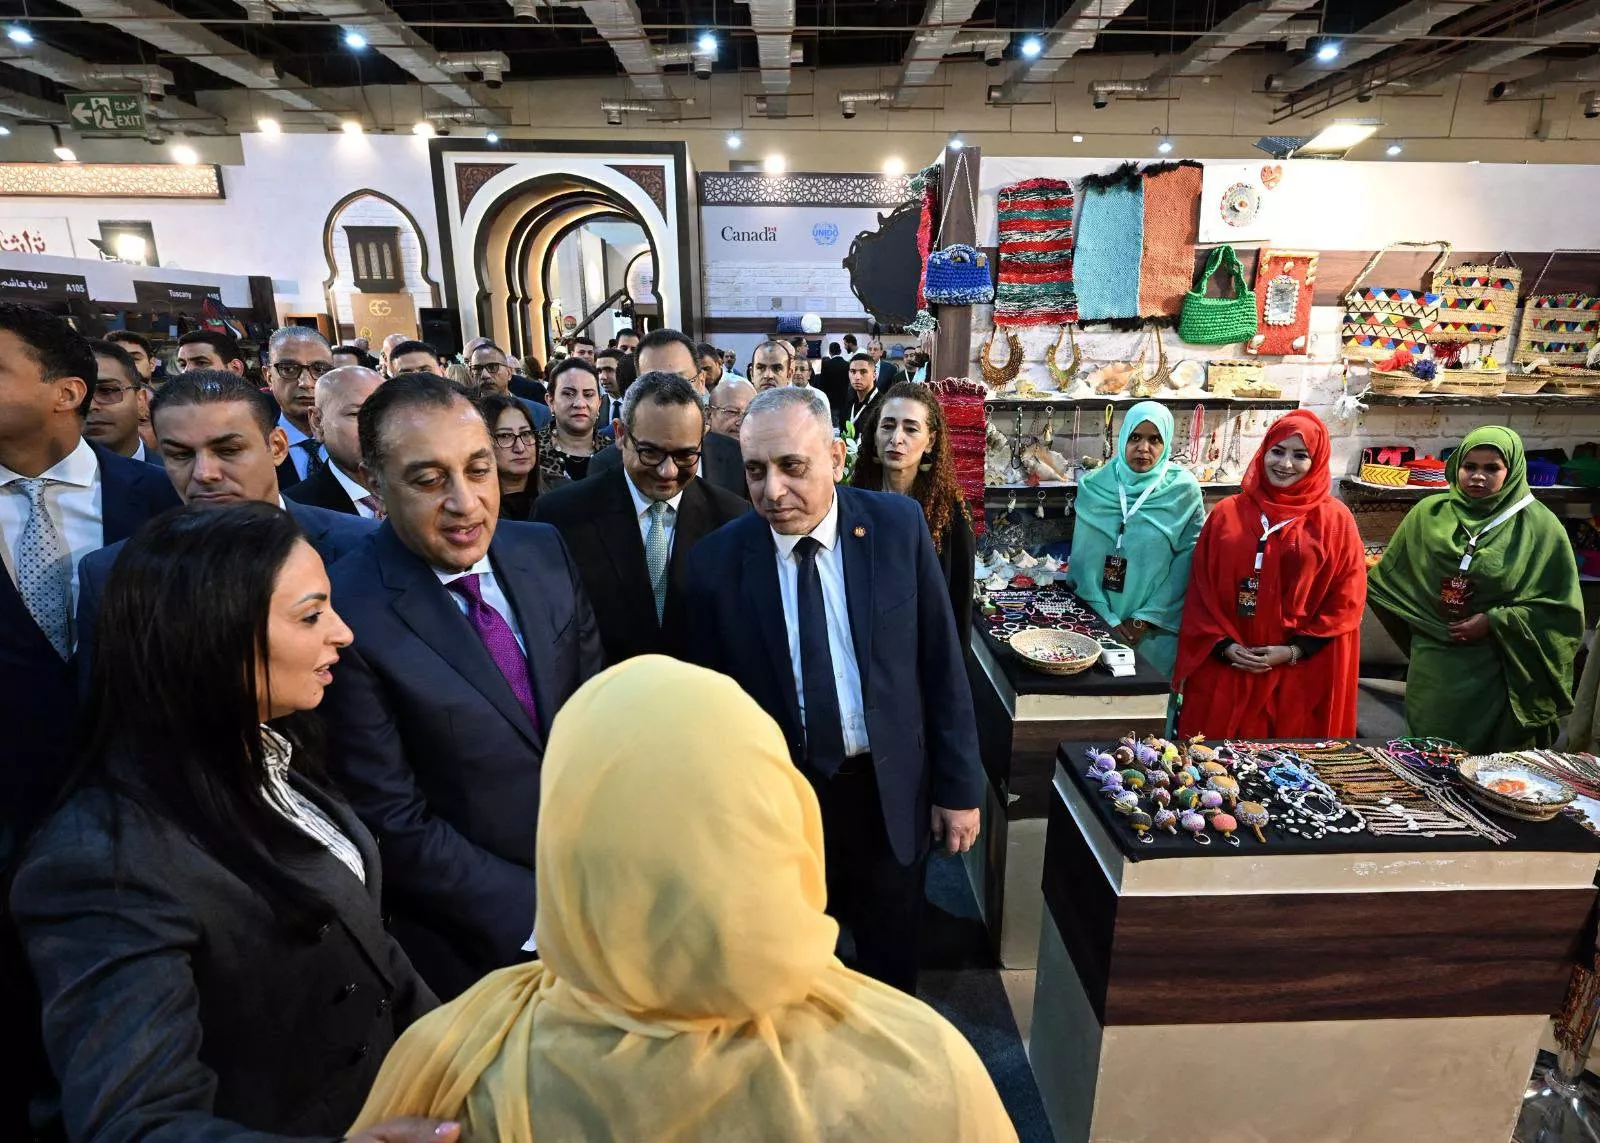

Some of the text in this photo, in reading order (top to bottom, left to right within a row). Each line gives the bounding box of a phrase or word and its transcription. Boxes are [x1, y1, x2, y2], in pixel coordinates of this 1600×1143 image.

[114, 100, 137, 111] خروج
[117, 115, 142, 127] EXIT
[721, 226, 777, 242] Canada
[812, 228, 839, 237] UNIDO
[27, 279, 48, 291] نادية
[66, 283, 85, 293] A105
[168, 289, 192, 300] Tuscany
